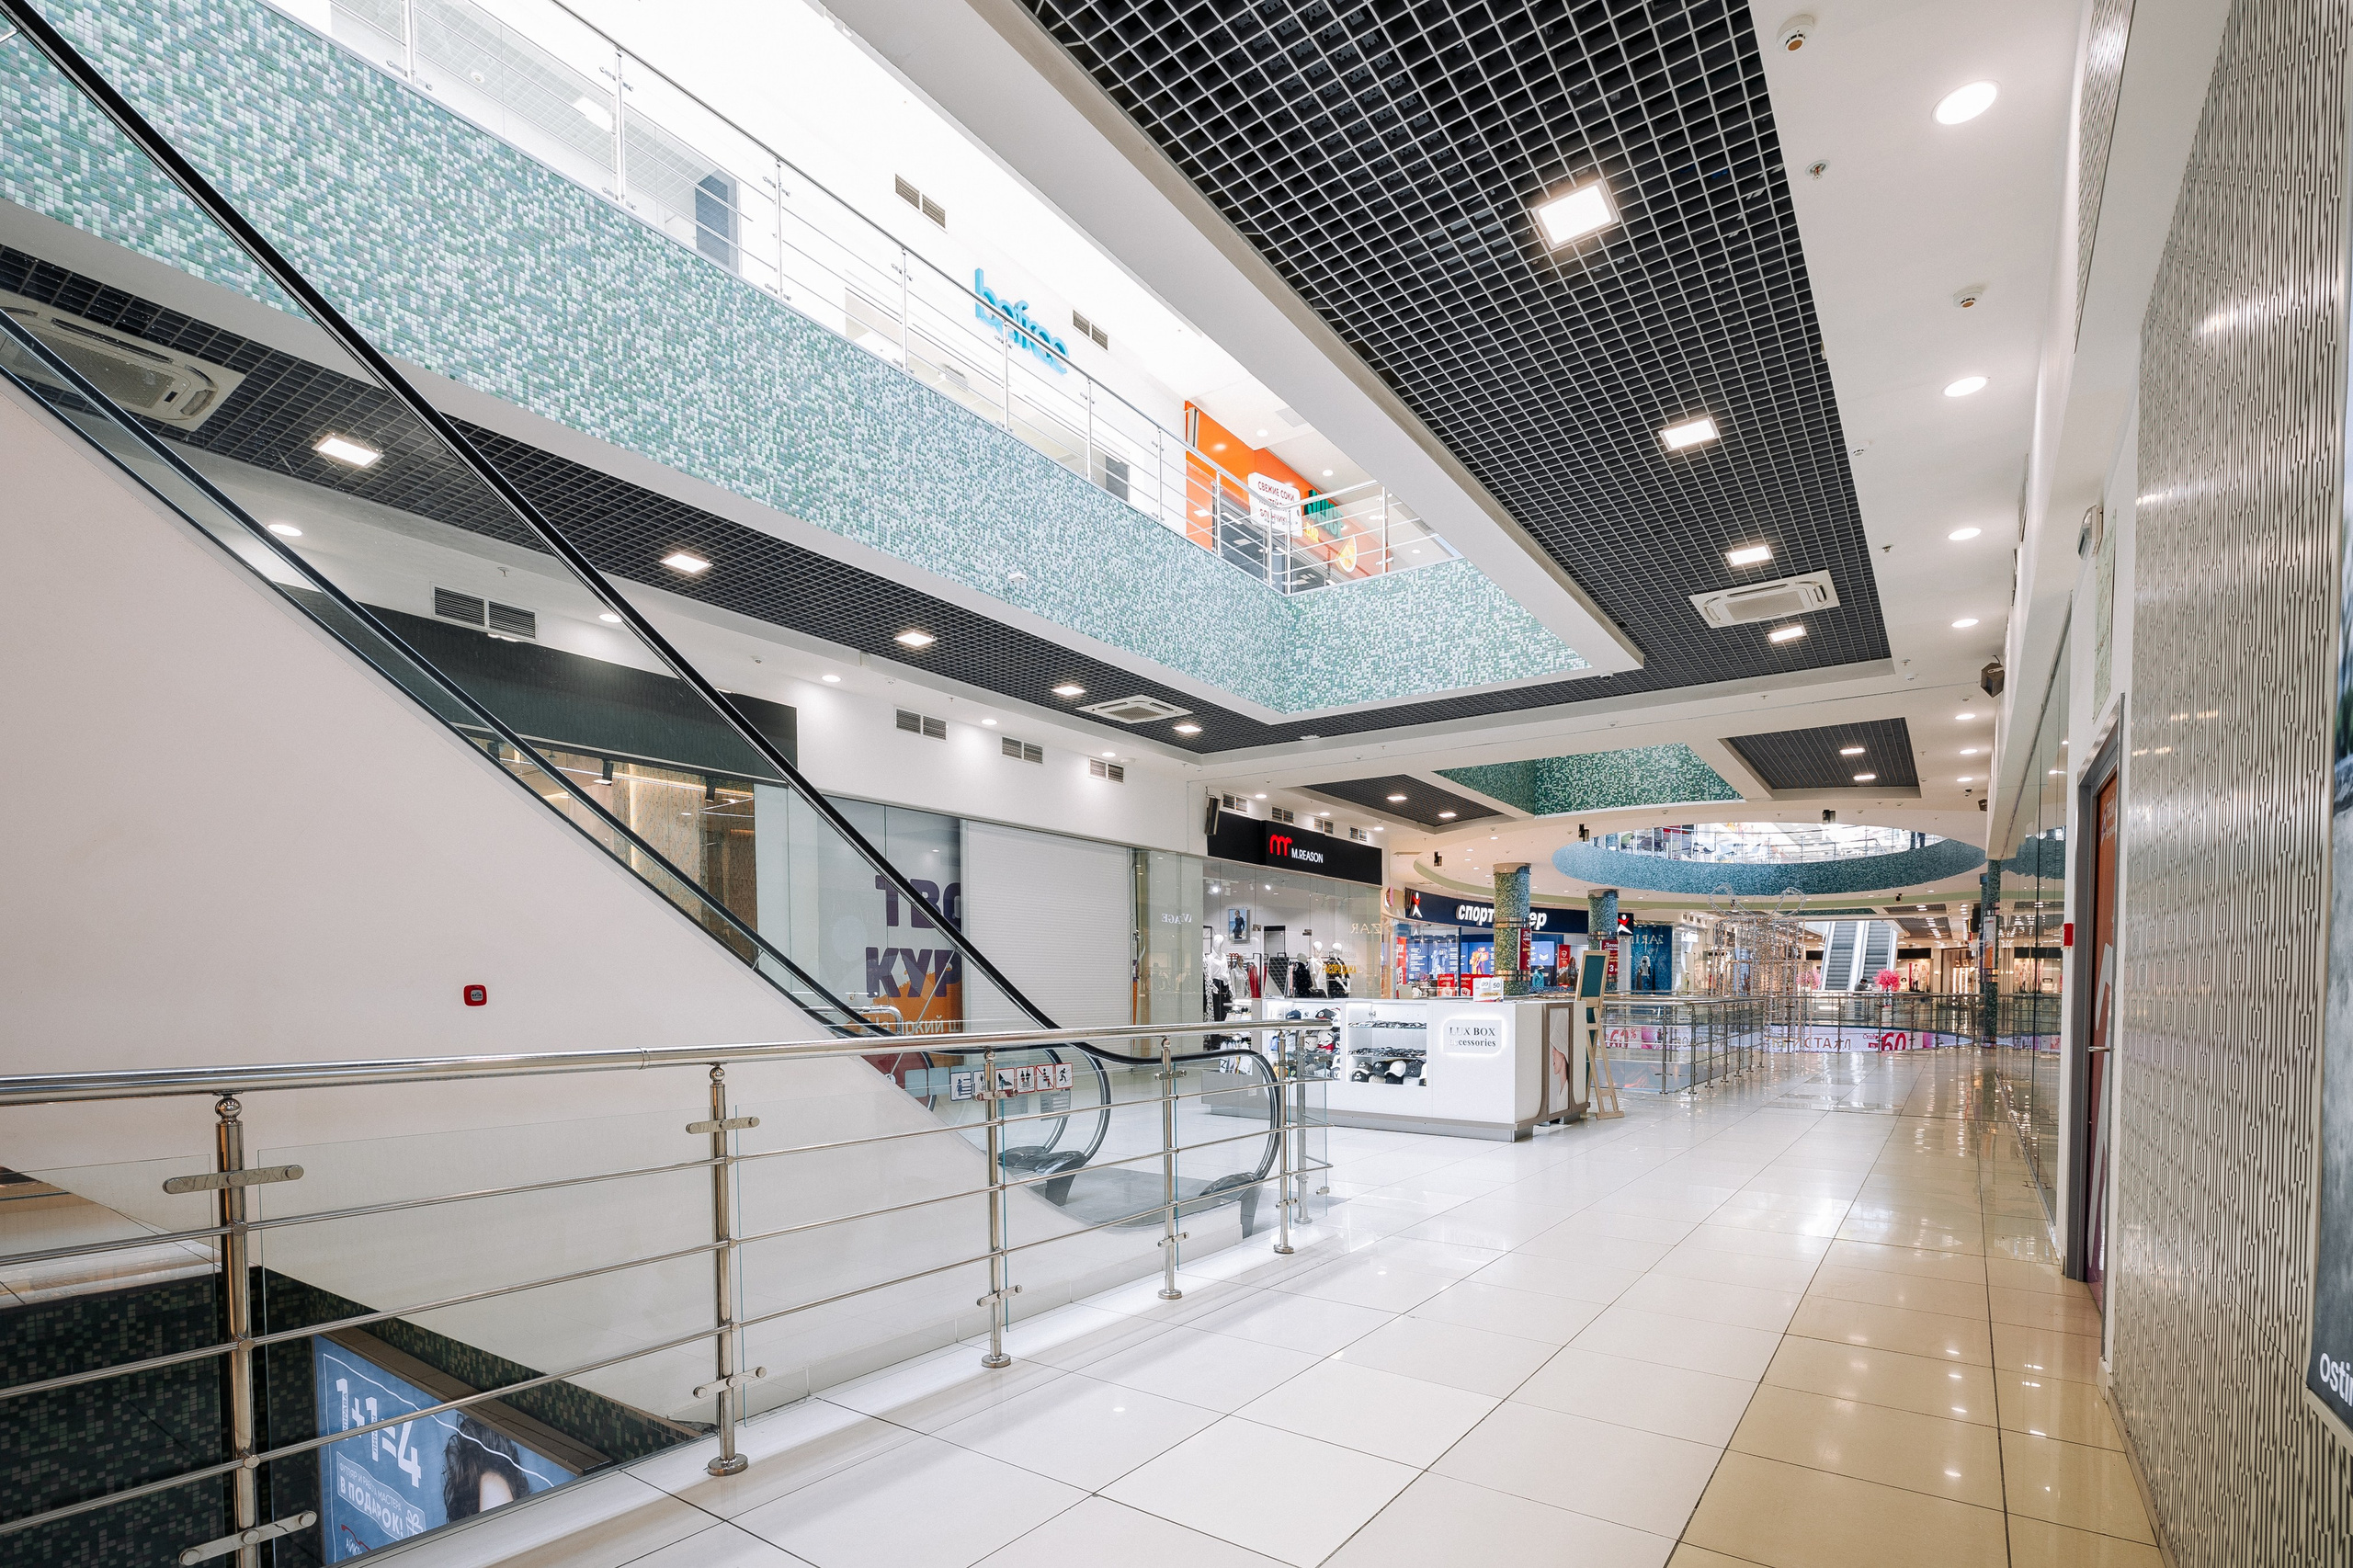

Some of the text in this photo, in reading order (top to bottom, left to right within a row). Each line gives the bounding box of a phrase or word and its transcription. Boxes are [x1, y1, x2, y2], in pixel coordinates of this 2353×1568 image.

[1257, 481, 1279, 497] СВЕЖИЕ
[1280, 490, 1295, 503] СОКИ
[1291, 847, 1324, 864] M.REASON
[1449, 1027, 1496, 1037] LUX BOX
[340, 1476, 404, 1538] В ПОДАРОК!
[378, 1491, 403, 1514] МАСТЕРА
